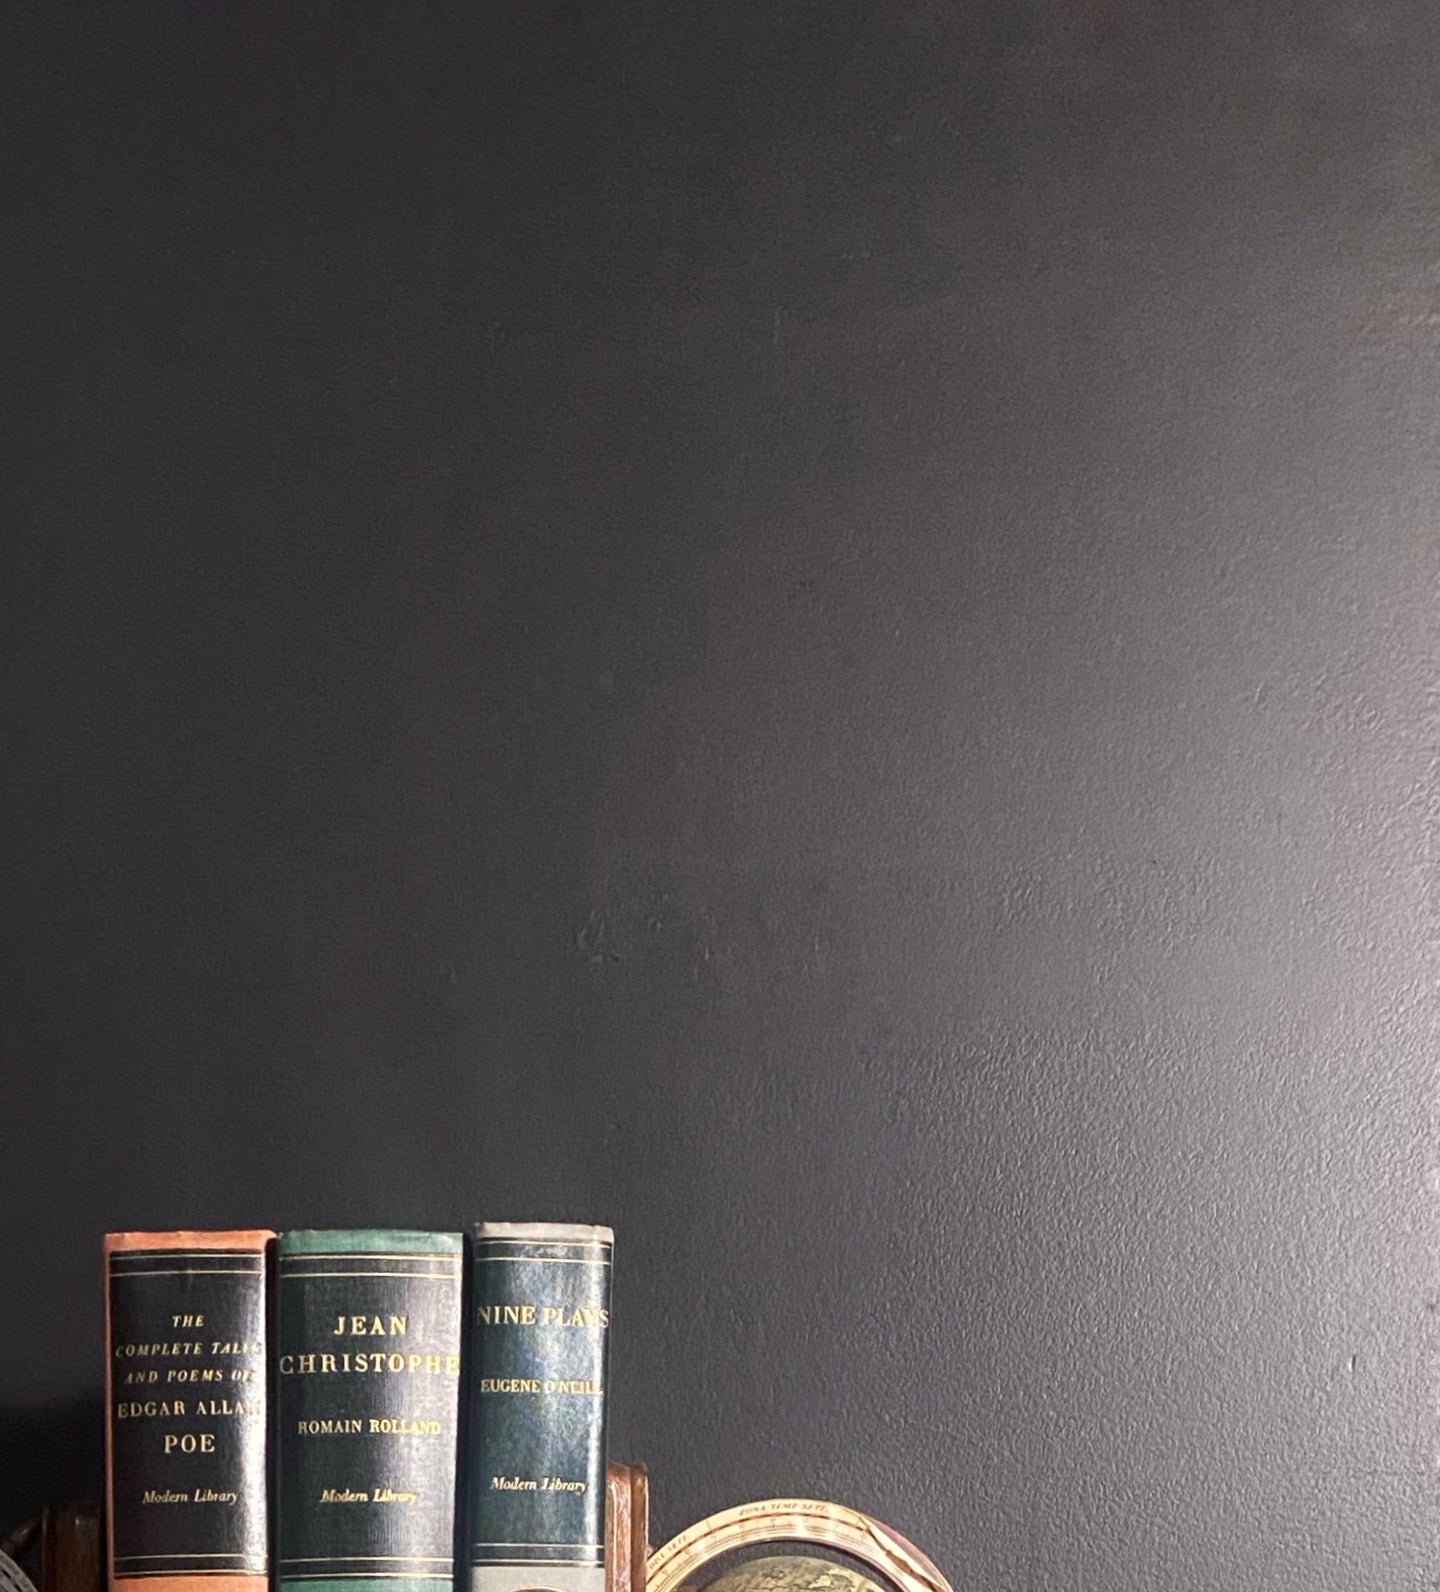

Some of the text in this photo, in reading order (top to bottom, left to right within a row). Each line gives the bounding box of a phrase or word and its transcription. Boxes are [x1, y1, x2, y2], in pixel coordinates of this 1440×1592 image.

[172, 1315, 204, 1328] THE
[477, 1305, 609, 1329] NINE PLAYS
[334, 1316, 407, 1336] JEAN
[115, 1342, 203, 1358] COMPLETE
[279, 1353, 460, 1376] CHRISTOPHE
[125, 1369, 254, 1384] AND POEMS OF
[480, 1378, 541, 1394] EUGENE
[118, 1400, 186, 1419] EDGAR
[298, 1418, 442, 1435] ROMAIN ROLLAND
[164, 1433, 215, 1454] POE
[490, 1476, 589, 1496] Modern Library
[142, 1488, 238, 1505] Modern Library
[320, 1488, 418, 1505] Modern Library
